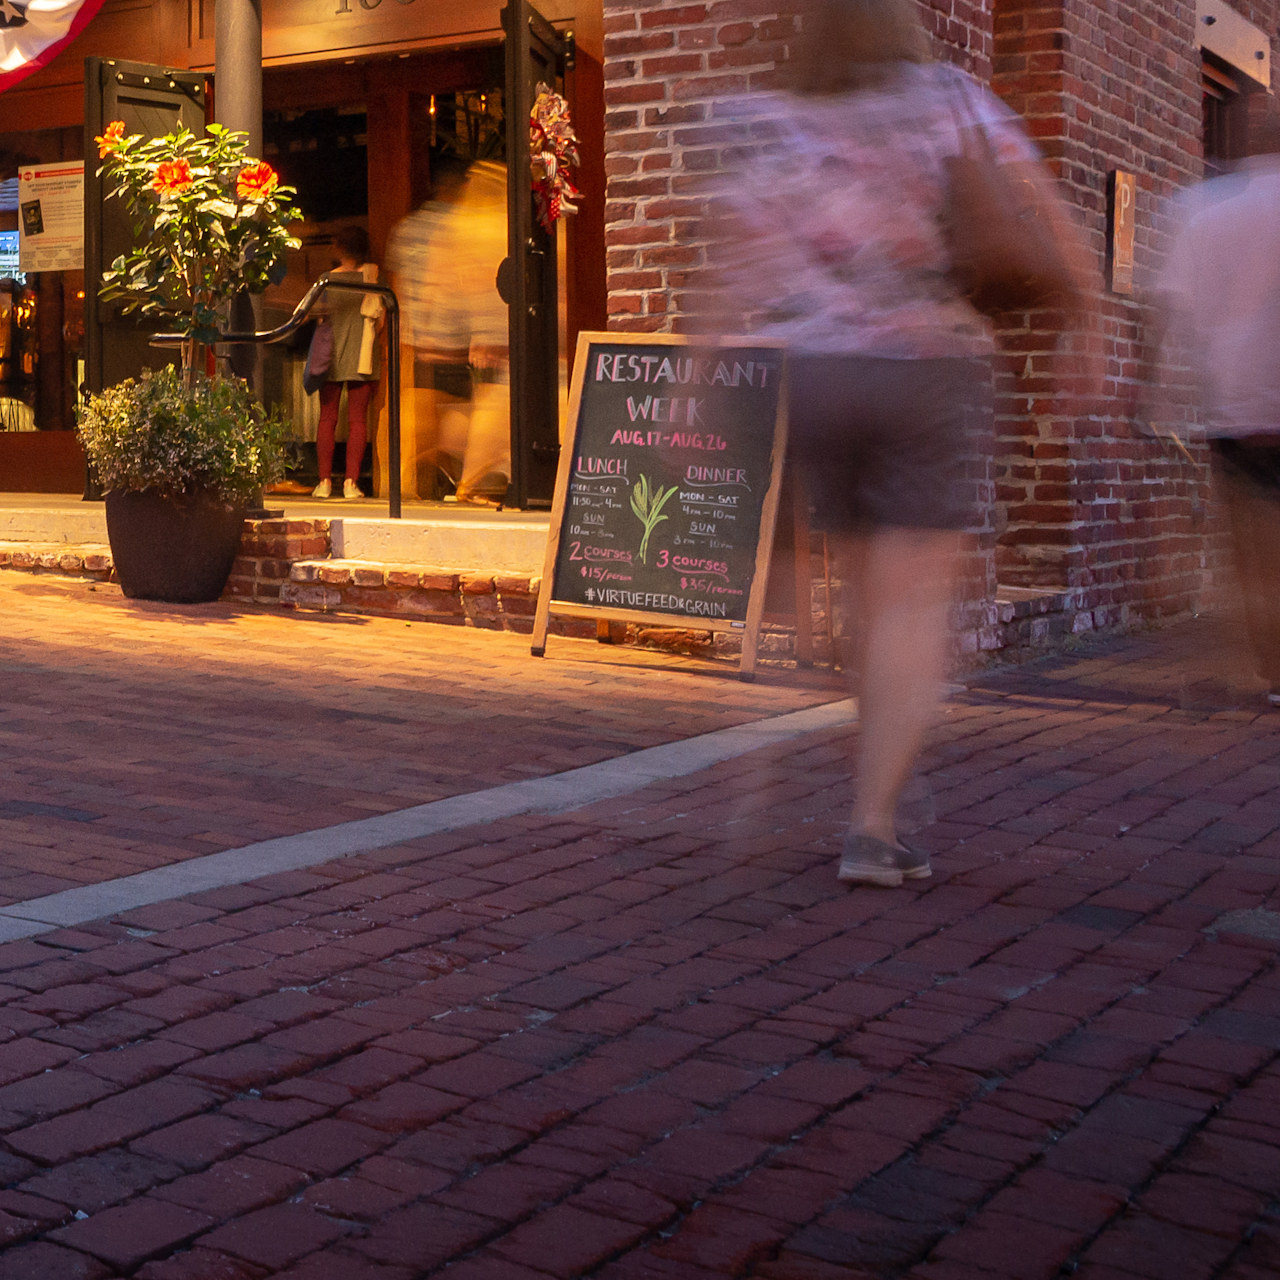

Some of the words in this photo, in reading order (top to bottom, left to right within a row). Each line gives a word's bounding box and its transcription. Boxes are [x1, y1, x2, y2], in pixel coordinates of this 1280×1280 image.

[596, 353, 773, 388] RESTAURANT
[626, 395, 704, 426] WEEK
[577, 456, 628, 475] LUNCH
[686, 465, 747, 483] DINNER
[600, 485, 617, 494] SAT
[679, 492, 704, 501] MON
[718, 494, 740, 504] SAT
[583, 512, 605, 523] SUN
[690, 521, 716, 534] SUN
[569, 541, 583, 561] 2
[584, 545, 632, 561] courses
[656, 550, 669, 568] 3
[672, 556, 728, 573] courses
[585, 587, 726, 617] #VIRTUEFEED&GRAIN
